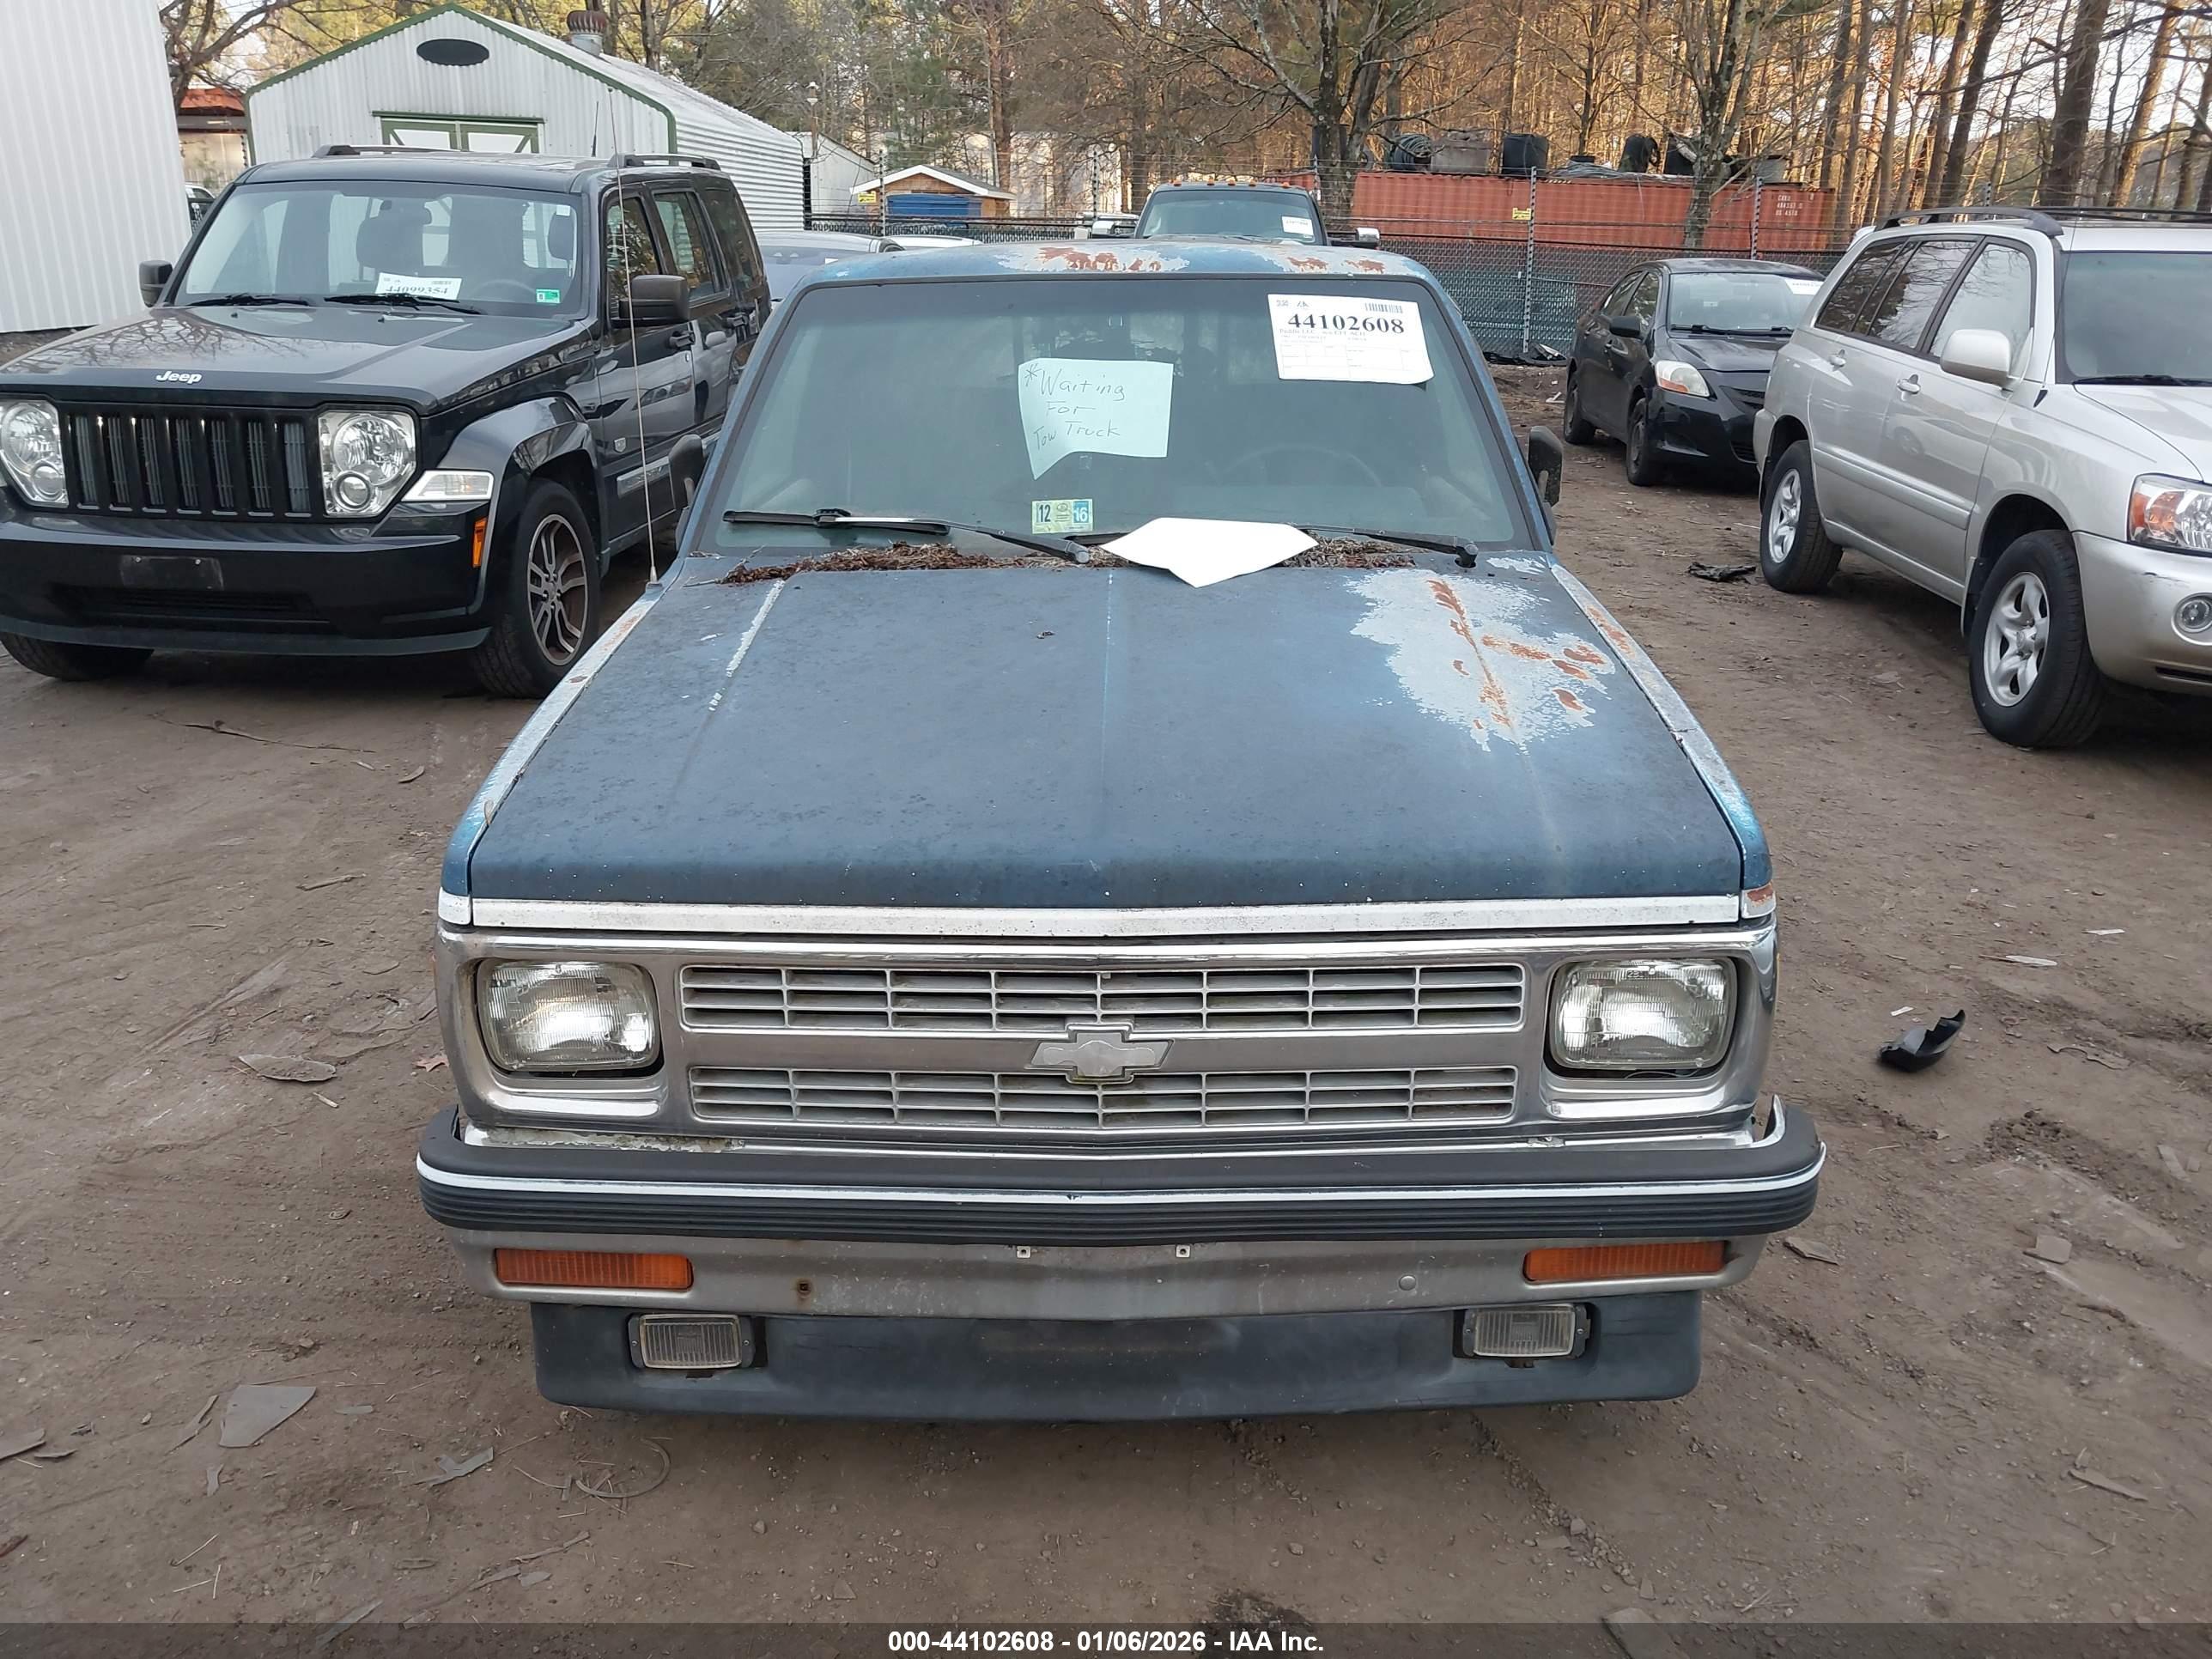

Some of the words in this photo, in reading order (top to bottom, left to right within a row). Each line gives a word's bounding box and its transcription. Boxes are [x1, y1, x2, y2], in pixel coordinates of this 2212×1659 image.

[1288, 313, 1405, 334] 44102608
[155, 370, 203, 385] Jeep
[1046, 400, 1097, 416] For
[1033, 425, 1057, 450] Tow
[1065, 419, 1121, 438] Truck
[1039, 504, 1051, 523] 12
[1073, 507, 1088, 522] 16
